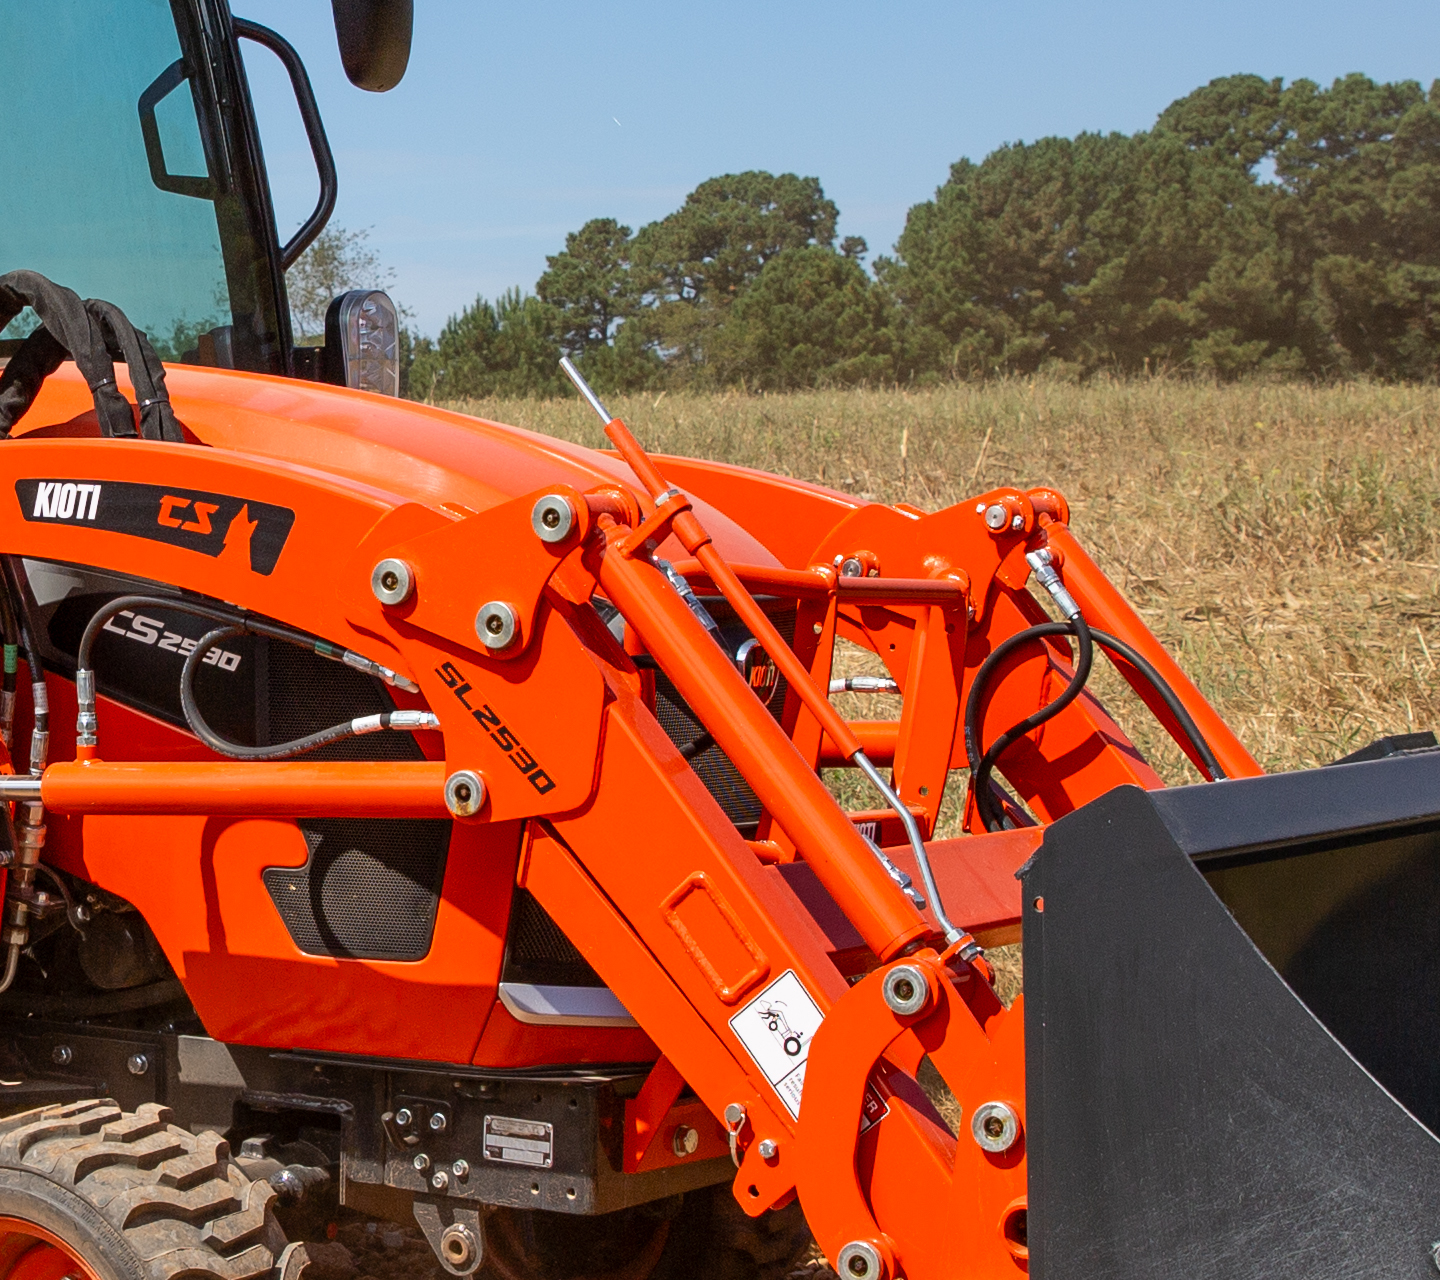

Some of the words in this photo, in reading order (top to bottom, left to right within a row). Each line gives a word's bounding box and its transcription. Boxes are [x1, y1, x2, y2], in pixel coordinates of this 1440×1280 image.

[32, 481, 101, 520] KIOTI
[157, 494, 220, 535] CS
[434, 661, 556, 795] SL2530
